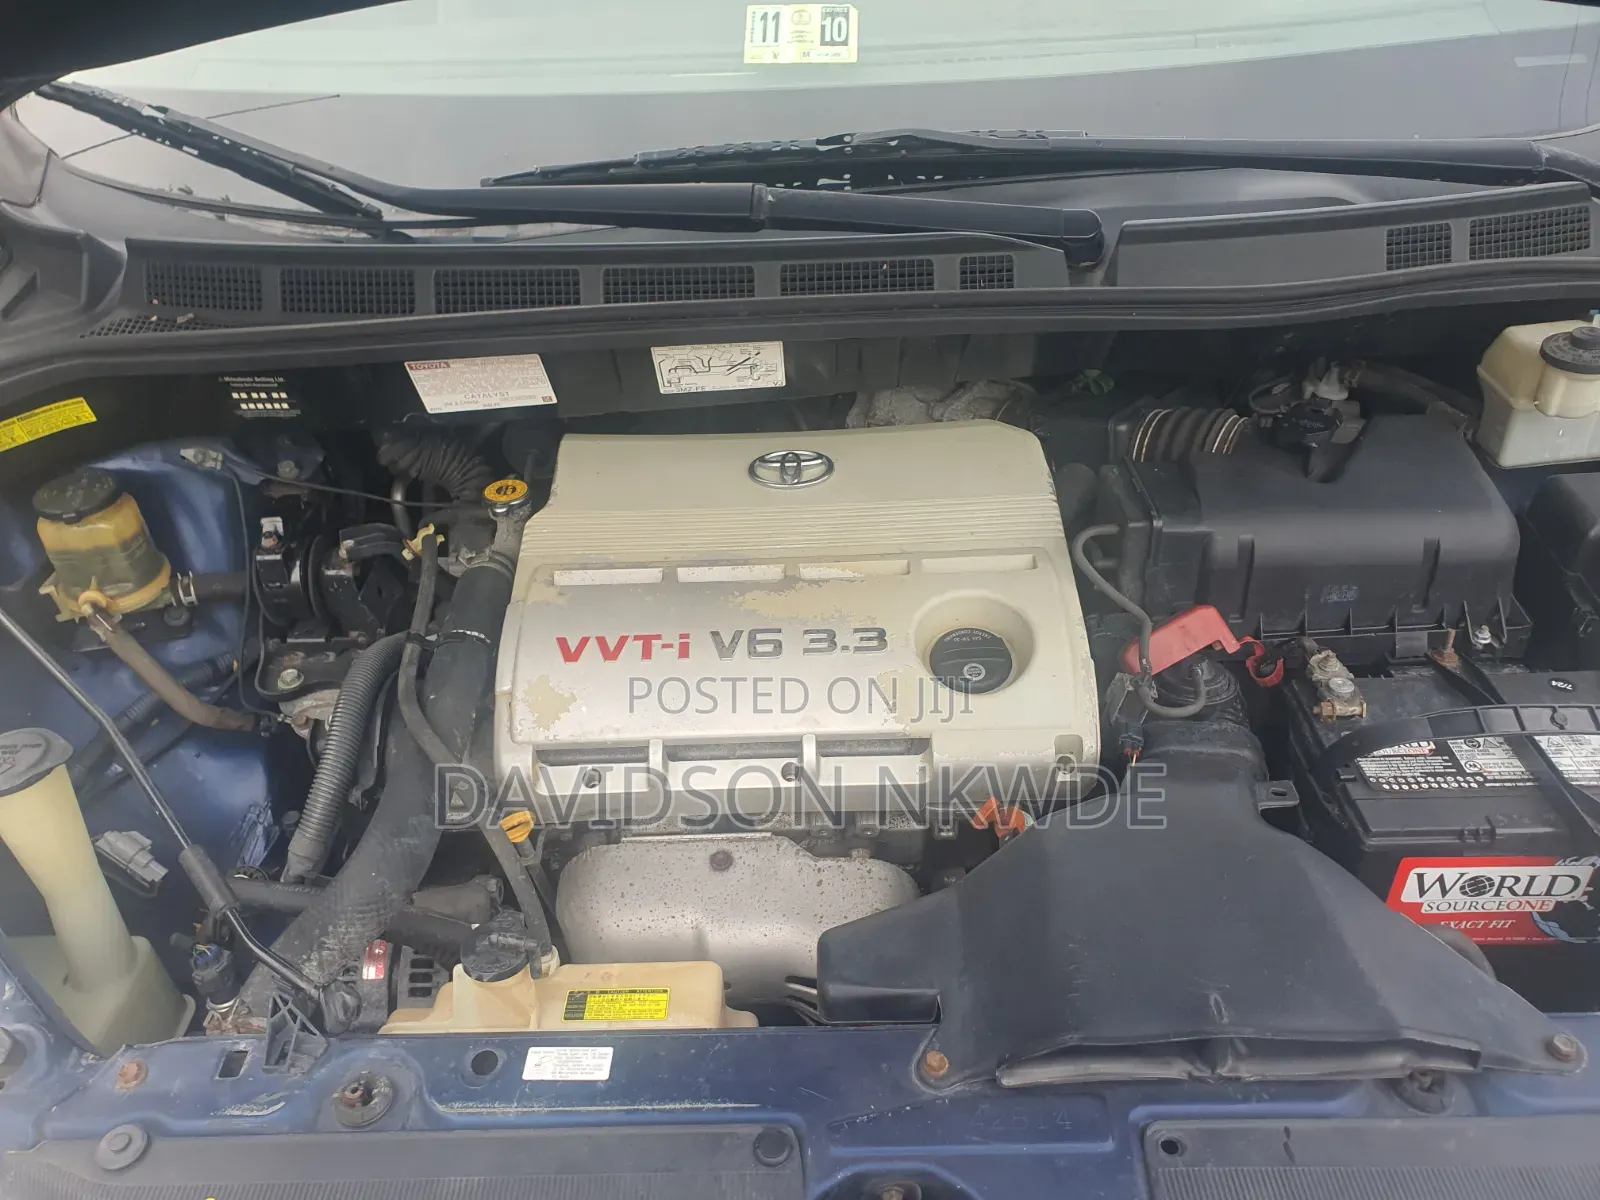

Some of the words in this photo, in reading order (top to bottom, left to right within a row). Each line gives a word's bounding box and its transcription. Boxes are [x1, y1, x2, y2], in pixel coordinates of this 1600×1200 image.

[760, 11, 780, 43] 11
[821, 16, 848, 42] 10
[410, 361, 448, 370] TOYOTA
[463, 391, 510, 400] CATALYST
[555, 632, 691, 663] VVT-i
[709, 627, 784, 661] V6
[802, 626, 889, 657] 3.3
[1413, 872, 1582, 899] WORLD
[1424, 900, 1551, 914] SOURCEONE
[1488, 920, 1516, 929] FIT
